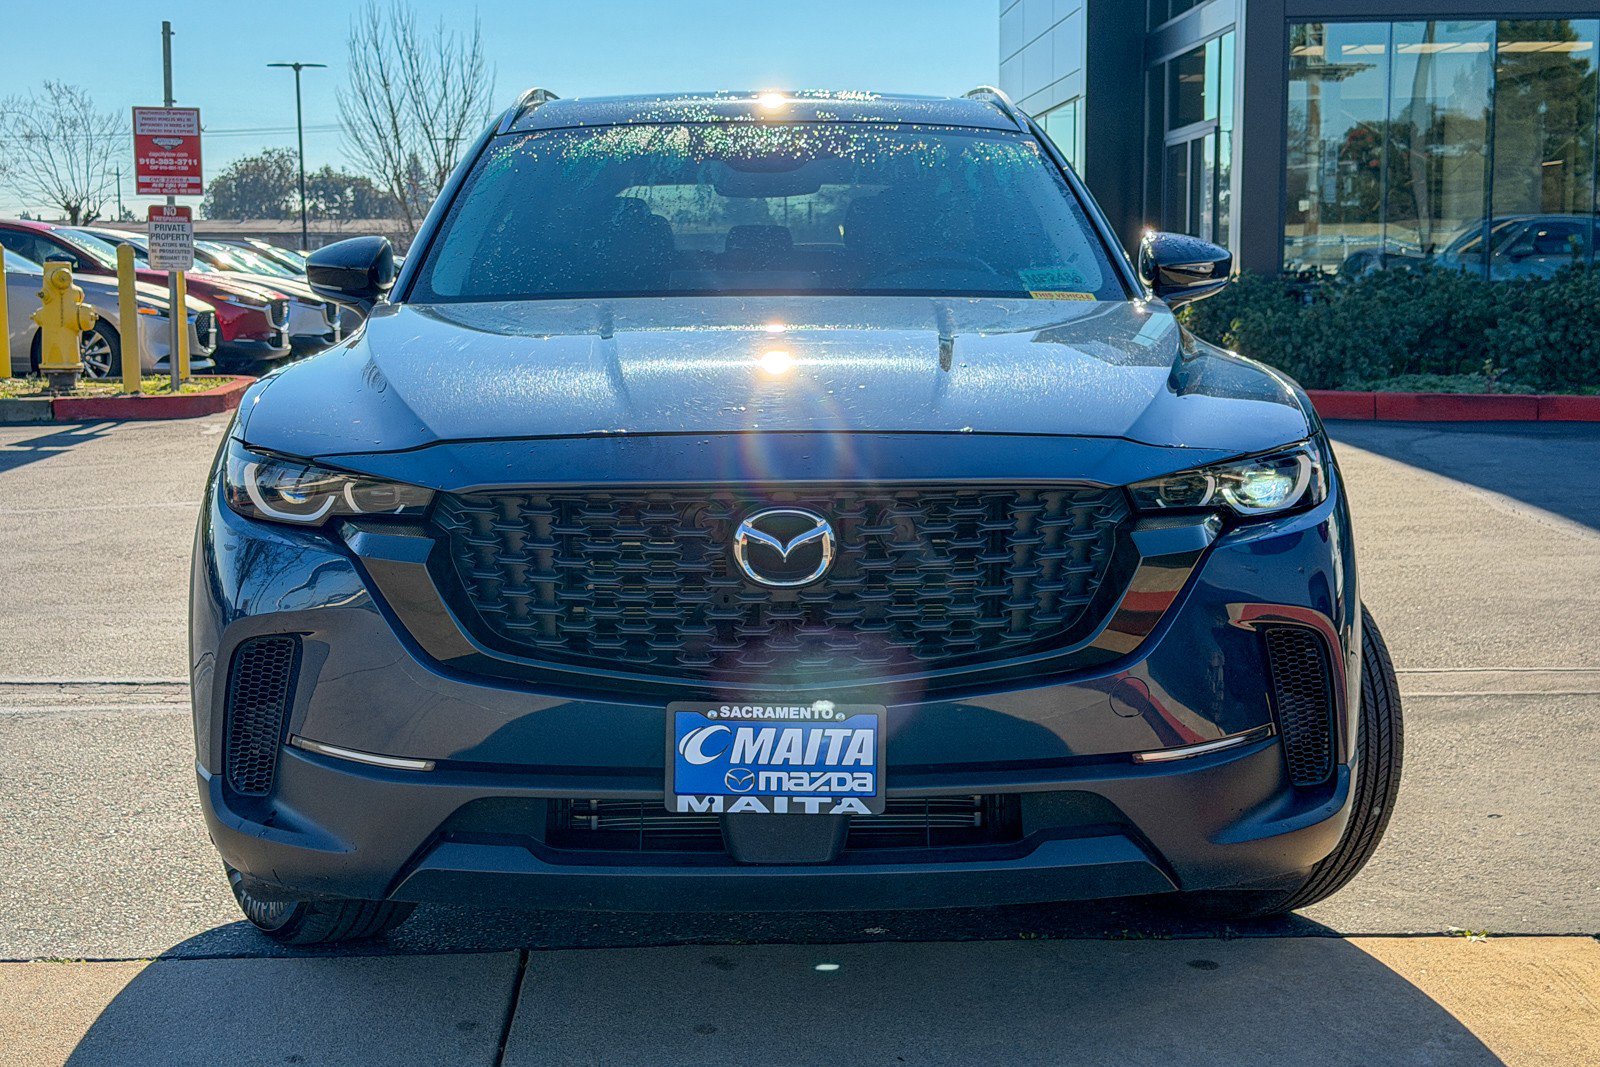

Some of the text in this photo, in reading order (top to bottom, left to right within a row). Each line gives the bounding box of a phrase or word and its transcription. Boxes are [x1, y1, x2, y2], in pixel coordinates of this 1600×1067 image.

[164, 206, 177, 216] NO
[150, 233, 190, 241] PROPERTY
[720, 706, 834, 720] SACRAMENTO
[677, 795, 872, 814] MAITA
